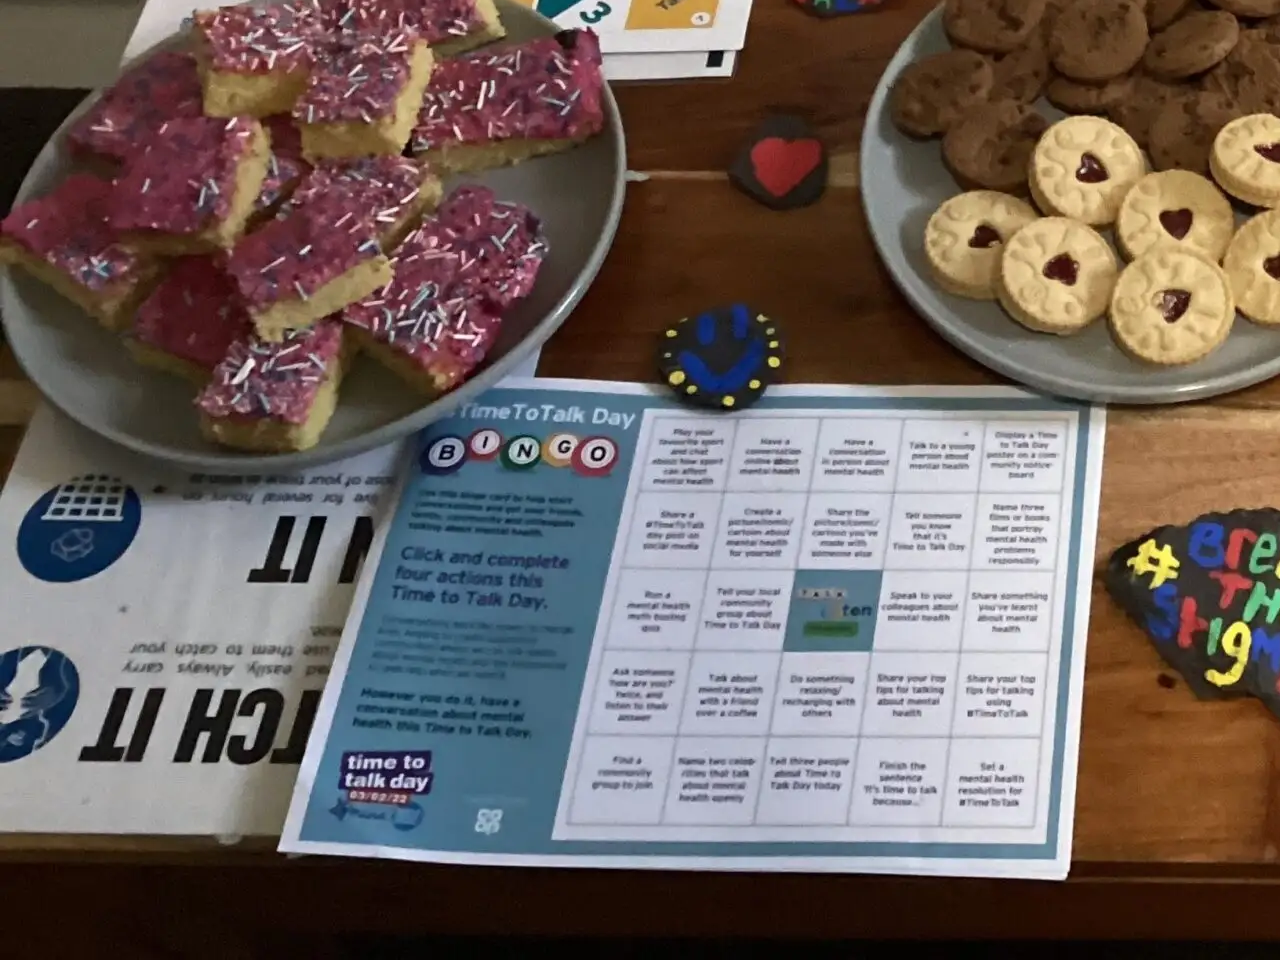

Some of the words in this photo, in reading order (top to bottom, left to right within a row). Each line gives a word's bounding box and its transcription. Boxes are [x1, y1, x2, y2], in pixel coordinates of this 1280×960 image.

[580, 1, 612, 24] 3
[452, 402, 585, 424] TimeToTalk
[591, 406, 636, 430] Day
[262, 493, 314, 505] several
[322, 493, 344, 506] for
[247, 516, 328, 584] IT
[401, 546, 450, 562] Click
[449, 550, 483, 566] and
[487, 553, 569, 570] complete
[396, 566, 432, 581] four
[436, 570, 503, 587] actions
[509, 573, 543, 588] this
[392, 585, 435, 603] Time
[440, 589, 460, 604] to
[466, 592, 502, 607] Talk
[130, 641, 167, 654] your
[175, 644, 218, 658] catch
[226, 645, 243, 658] to
[252, 645, 294, 658] them
[122, 660, 164, 676] carry
[177, 660, 235, 678] Always
[79, 687, 166, 763] IT
[347, 754, 398, 770] time
[403, 755, 426, 770] to
[345, 773, 386, 789] talk
[390, 775, 429, 793] day
